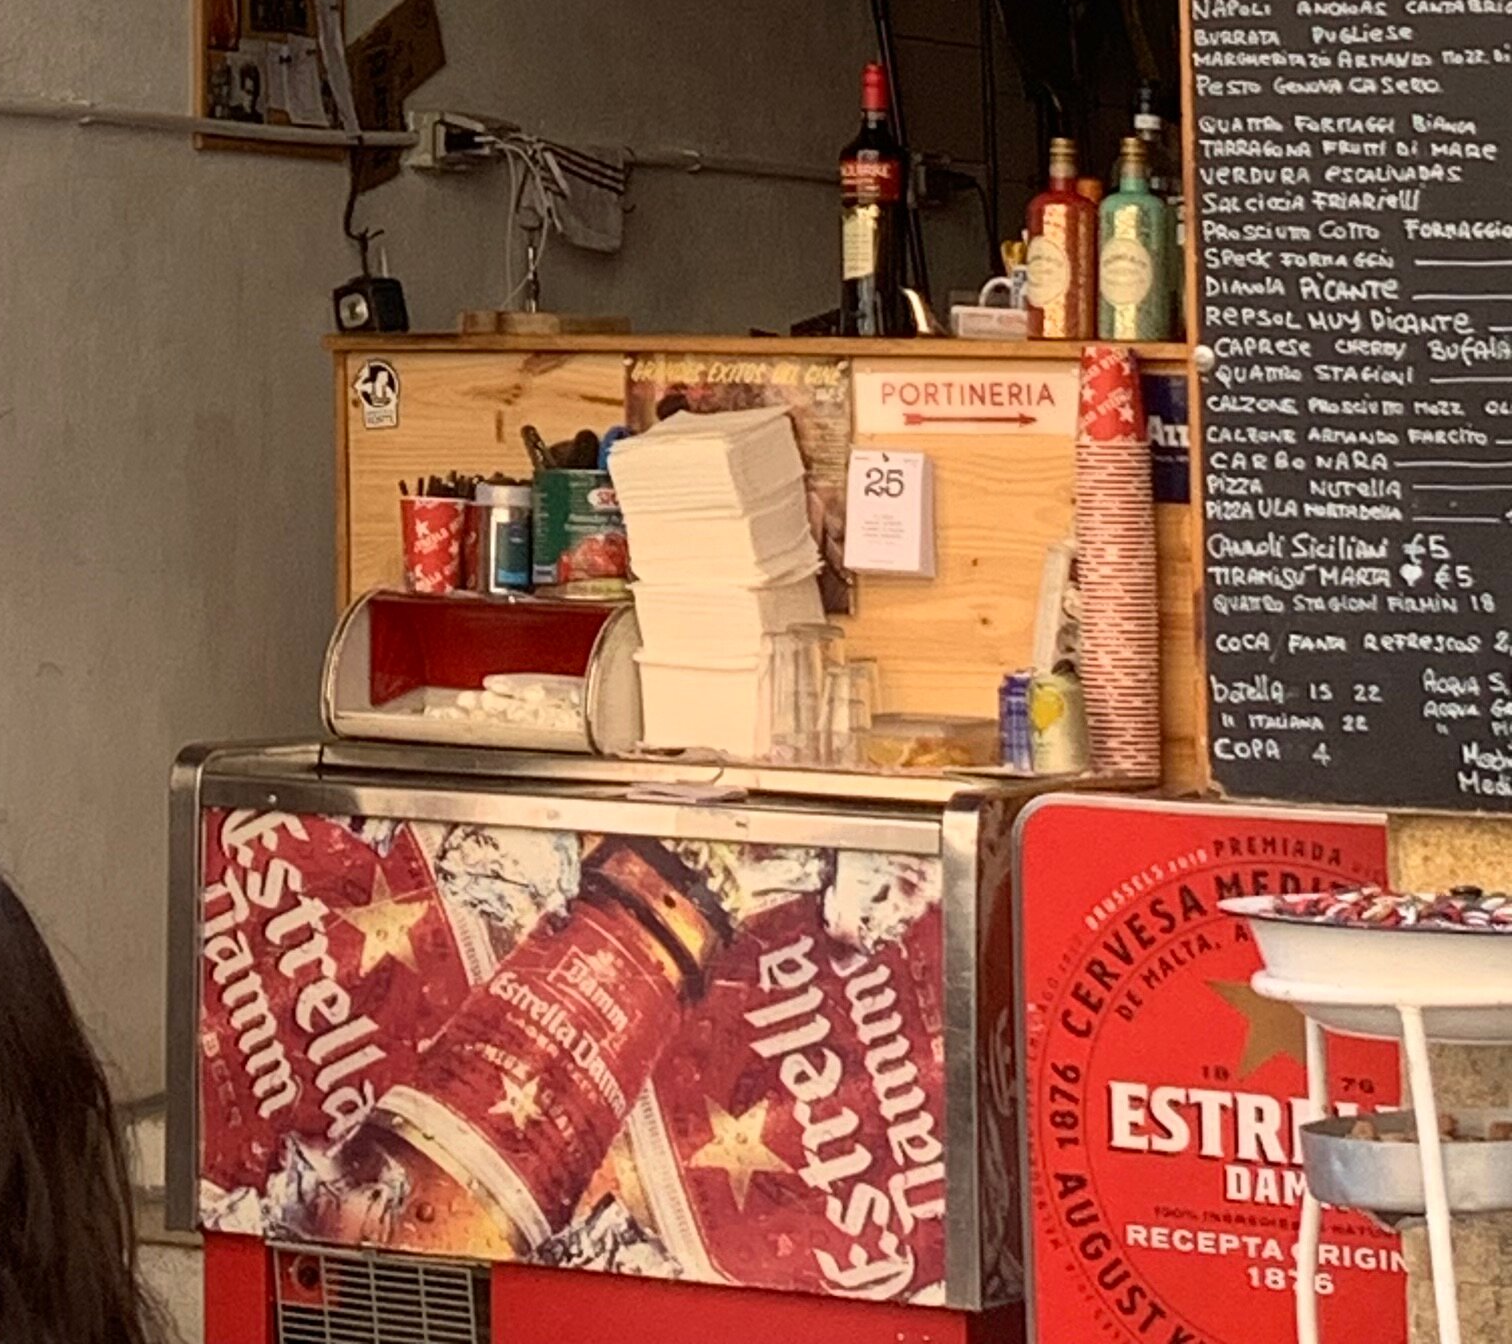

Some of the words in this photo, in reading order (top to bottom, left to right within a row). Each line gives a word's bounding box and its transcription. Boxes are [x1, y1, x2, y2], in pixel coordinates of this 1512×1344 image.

[882, 382, 1056, 407] PORTINERIA
[864, 467, 905, 499] 25
[1470, 595, 1496, 613] 18
[1354, 684, 1384, 702] 22
[1214, 738, 1281, 760] COPA
[1312, 743, 1331, 767] 4
[1212, 835, 1342, 867] PREMIADA
[221, 810, 387, 1142] Estrella
[1060, 884, 1208, 1040] CERVESA
[565, 957, 629, 1033] Damm
[1117, 990, 1143, 1024] DE
[489, 970, 577, 1050] Estrella
[572, 1029, 628, 1120] Damm
[744, 934, 916, 1301] Estrella
[1049, 1061, 1081, 1150] 1876
[1053, 1171, 1167, 1335] AUGUST
[1125, 1223, 1284, 1262] RECEPTA
